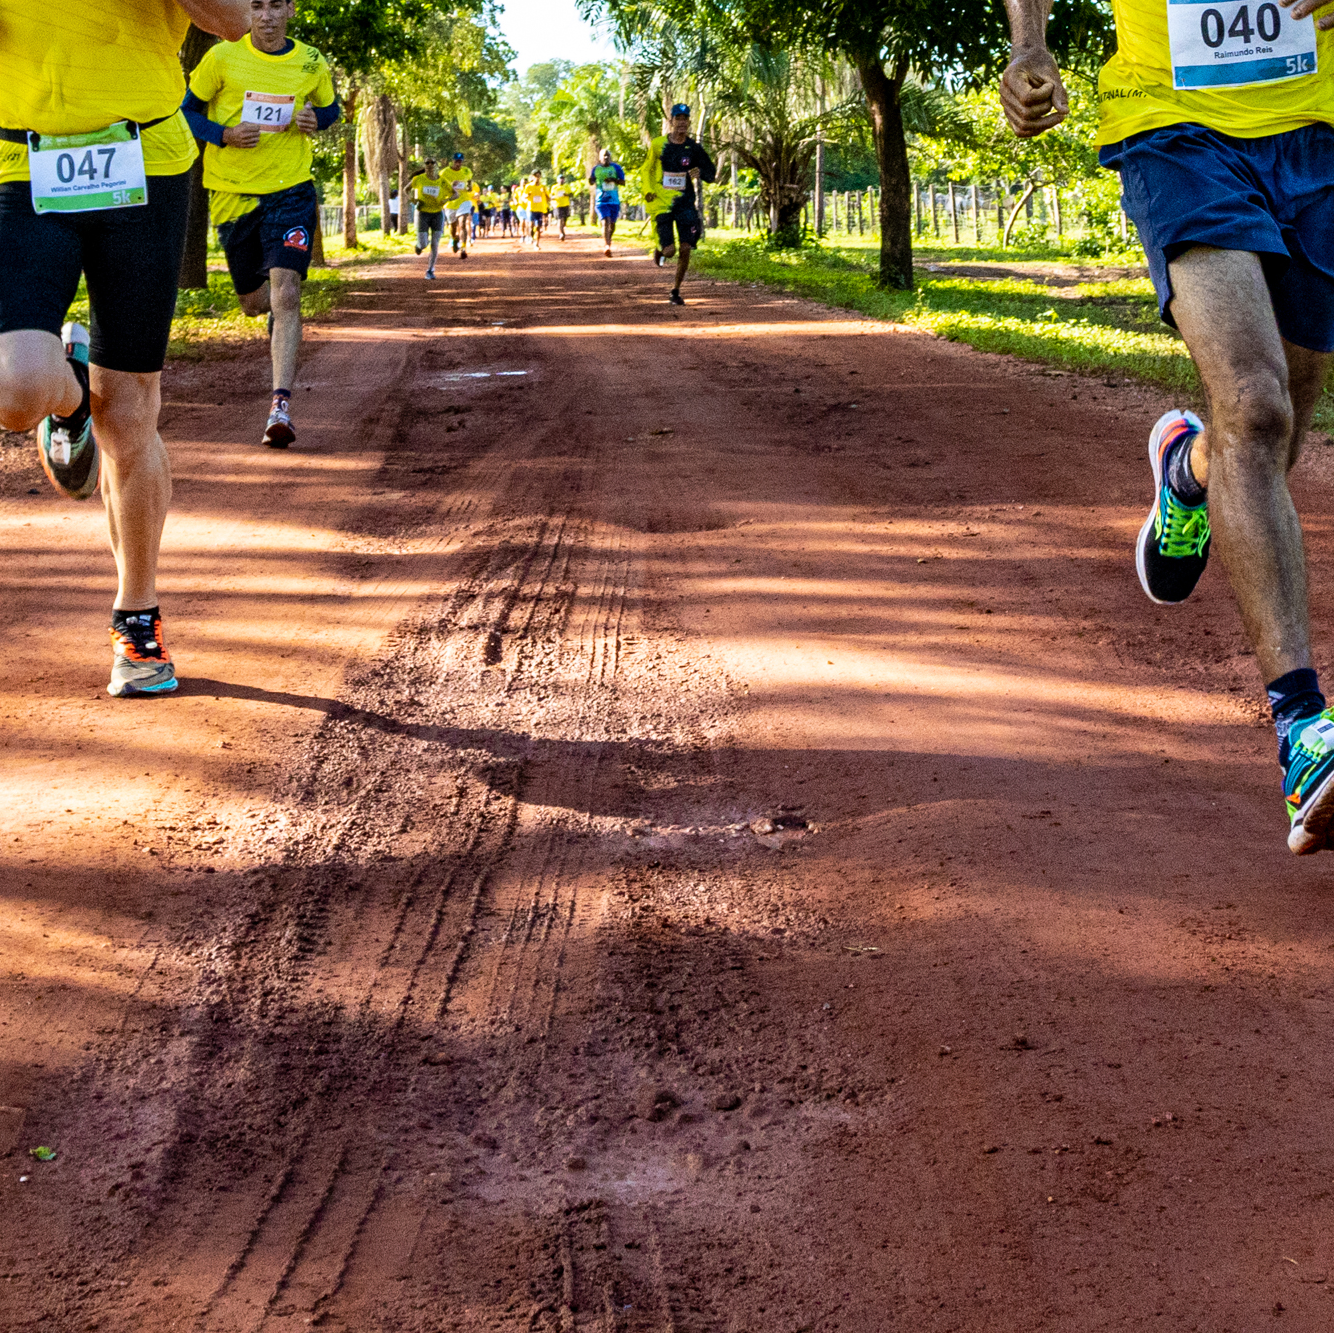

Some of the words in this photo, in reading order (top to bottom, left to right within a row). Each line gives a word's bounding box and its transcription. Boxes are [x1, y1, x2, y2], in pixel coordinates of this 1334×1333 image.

[1200, 2, 1282, 48] 040
[1214, 48, 1254, 59] Raimundo
[1255, 46, 1274, 55] Reis
[1285, 55, 1308, 75] 5k
[254, 105, 282, 122] 121
[56, 147, 116, 184] 047
[112, 190, 131, 205] 5k
